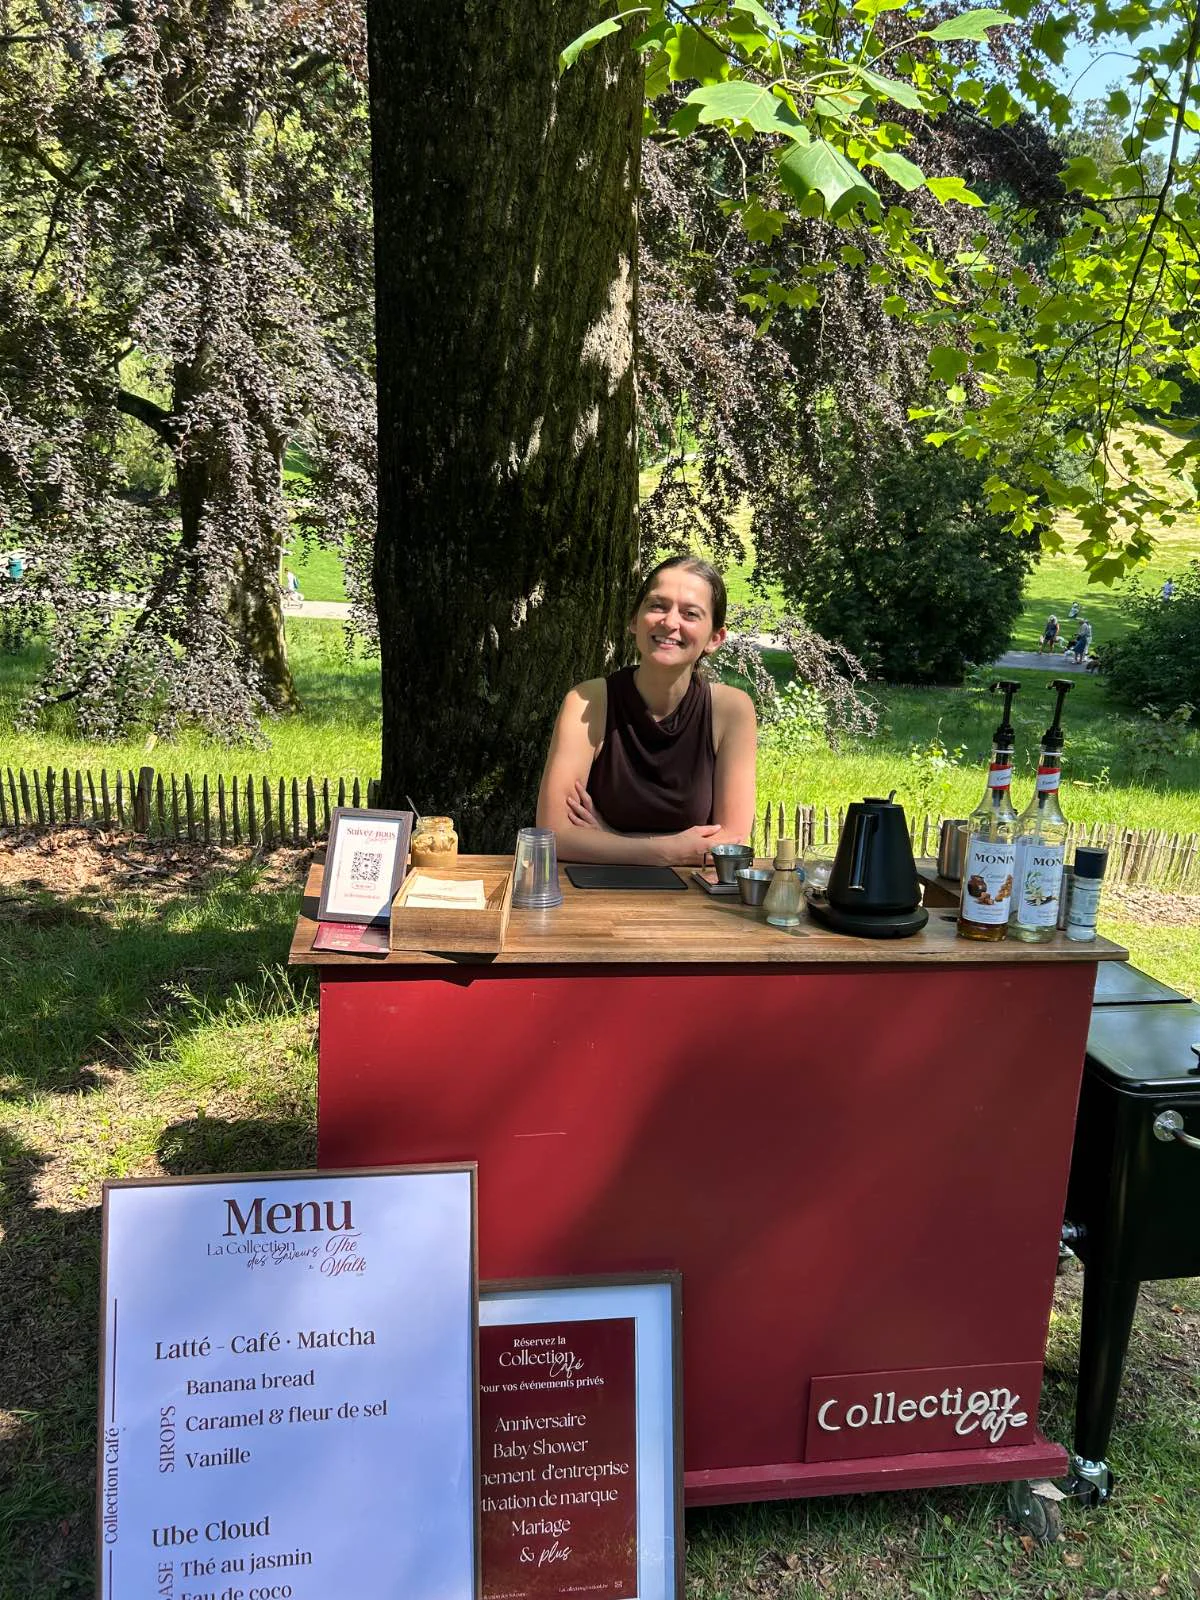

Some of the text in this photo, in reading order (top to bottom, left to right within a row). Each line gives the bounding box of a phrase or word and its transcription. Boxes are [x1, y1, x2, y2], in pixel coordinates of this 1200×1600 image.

[1033, 857, 1063, 867] MON
[222, 1197, 355, 1237] Menu
[207, 1240, 296, 1256] La Collection
[325, 1232, 362, 1257] The
[247, 1254, 269, 1271] des
[320, 1254, 367, 1277] Walk
[155, 1335, 211, 1360] Latté
[230, 1331, 281, 1355] Café
[297, 1326, 376, 1350] Matcha
[513, 1335, 566, 1348] Réservez la
[499, 1349, 576, 1367] Collection
[550, 1353, 584, 1378] Café
[186, 1369, 316, 1396] Banana bread
[502, 1383, 518, 1392] vos
[519, 1379, 574, 1391] événements
[576, 1376, 605, 1389] privés
[185, 1399, 388, 1432] Caramel & fleur de sel
[817, 1387, 1012, 1432] Collection
[495, 1413, 587, 1433] Anniversaire
[159, 1405, 176, 1473] SIROPS
[493, 1438, 589, 1460] Baby Shower
[185, 1447, 251, 1469] Vanille
[104, 1427, 120, 1545] Collection Café
[481, 1461, 629, 1486] nement d'entreprise
[481, 1489, 618, 1512] tivation de marque
[152, 1516, 271, 1548] Ube Cloud
[511, 1518, 571, 1538] Mariage
[181, 1548, 312, 1578] Thé au jasmin
[519, 1541, 573, 1567] & plus
[158, 1561, 174, 1600] ASE
[249, 1584, 292, 1600] coco
